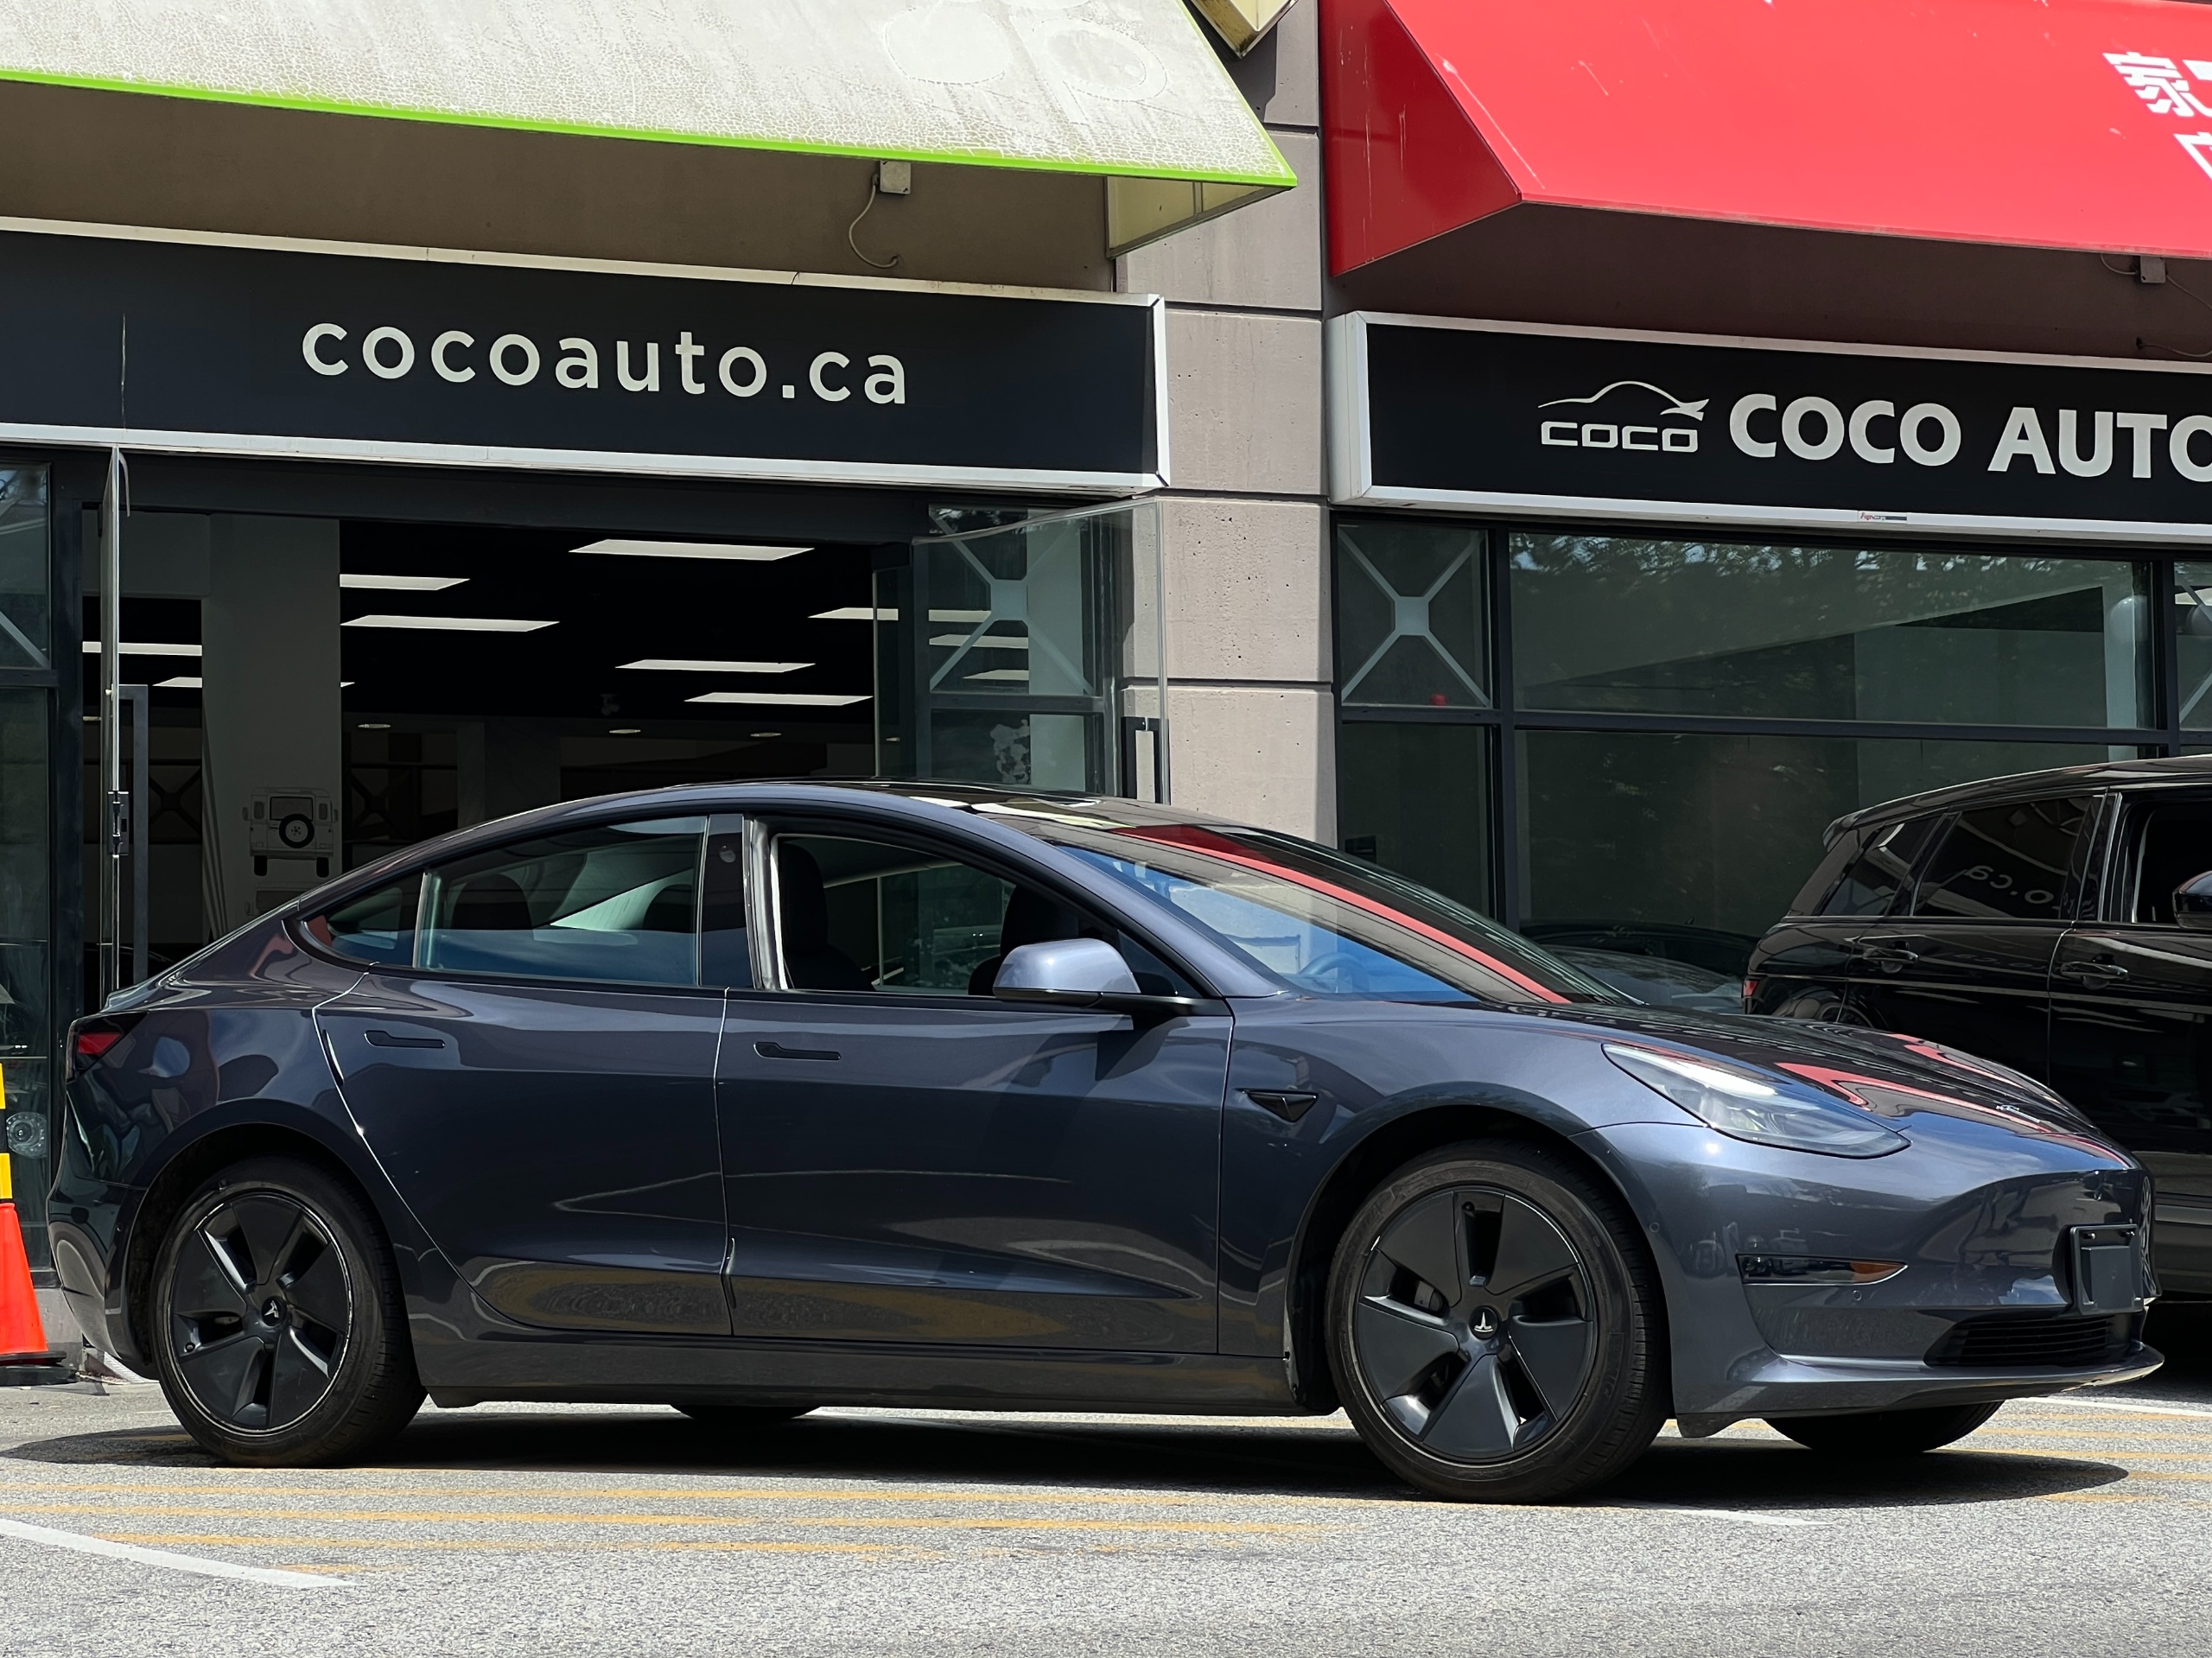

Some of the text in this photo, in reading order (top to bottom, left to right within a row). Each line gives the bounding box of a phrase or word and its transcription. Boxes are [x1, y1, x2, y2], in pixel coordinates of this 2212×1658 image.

[302, 322, 906, 404] cocoauto.ca
[1541, 421, 1699, 453] COCO
[1729, 393, 2212, 482] COCO AUTO
